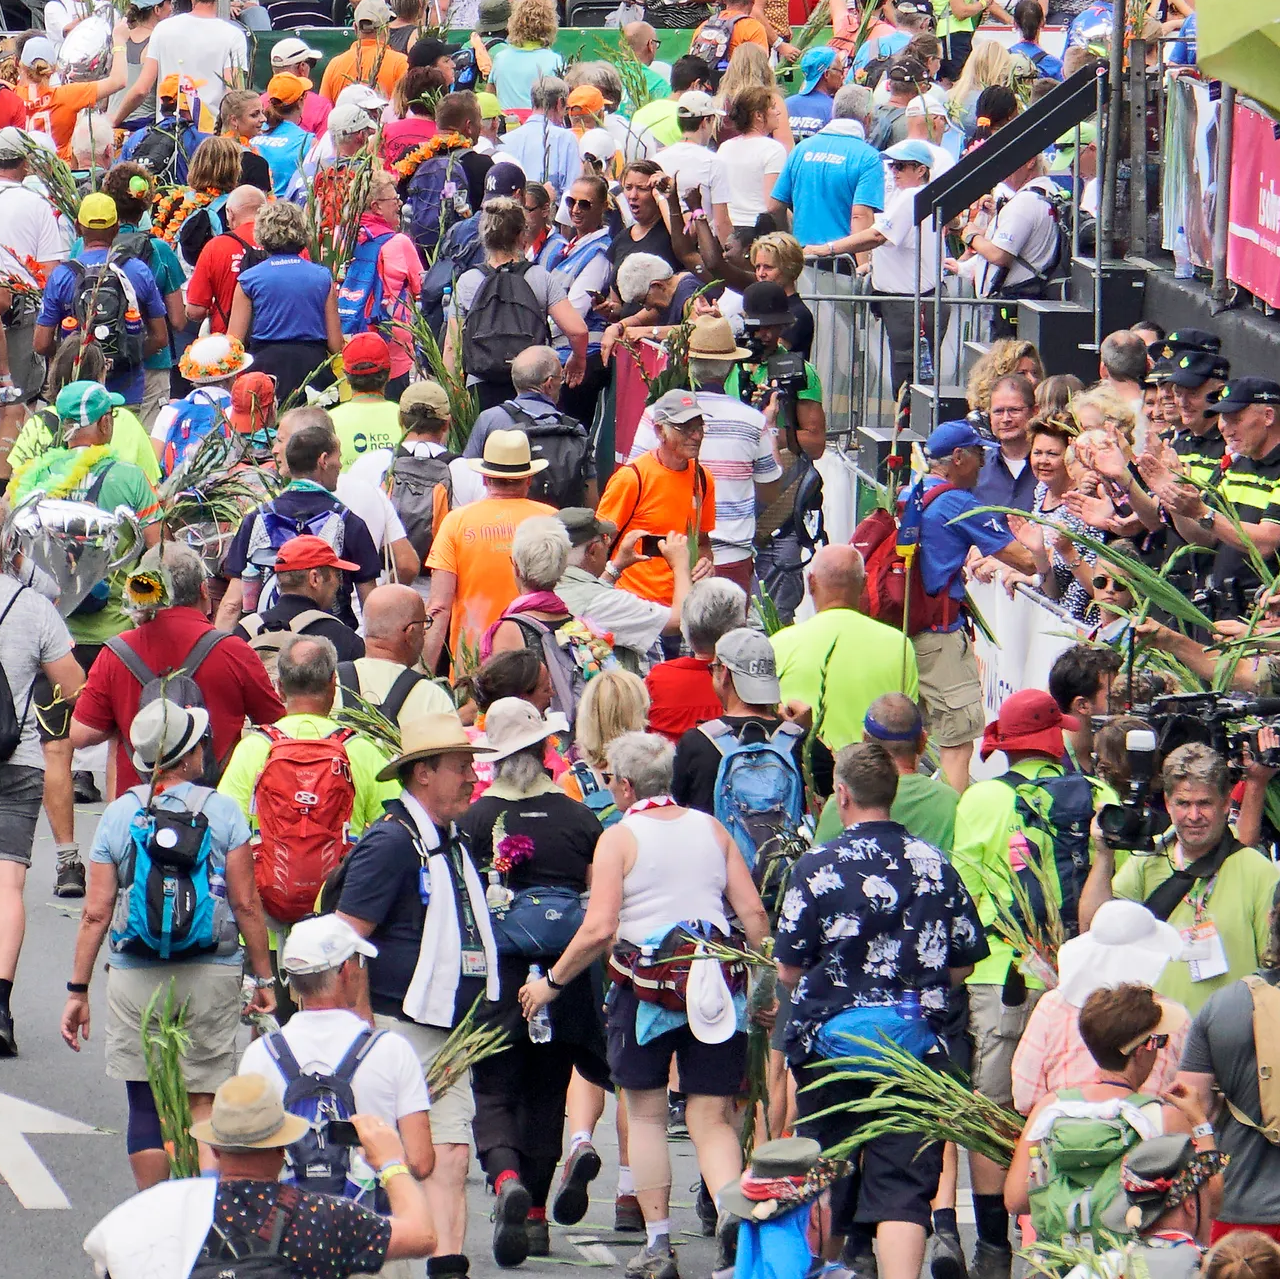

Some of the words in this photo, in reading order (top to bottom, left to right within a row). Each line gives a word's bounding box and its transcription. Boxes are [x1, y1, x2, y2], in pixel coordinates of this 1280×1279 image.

[812, 152, 846, 165] HI-TEC
[270, 258, 301, 267] kadaster
[369, 432, 390, 441] kro
